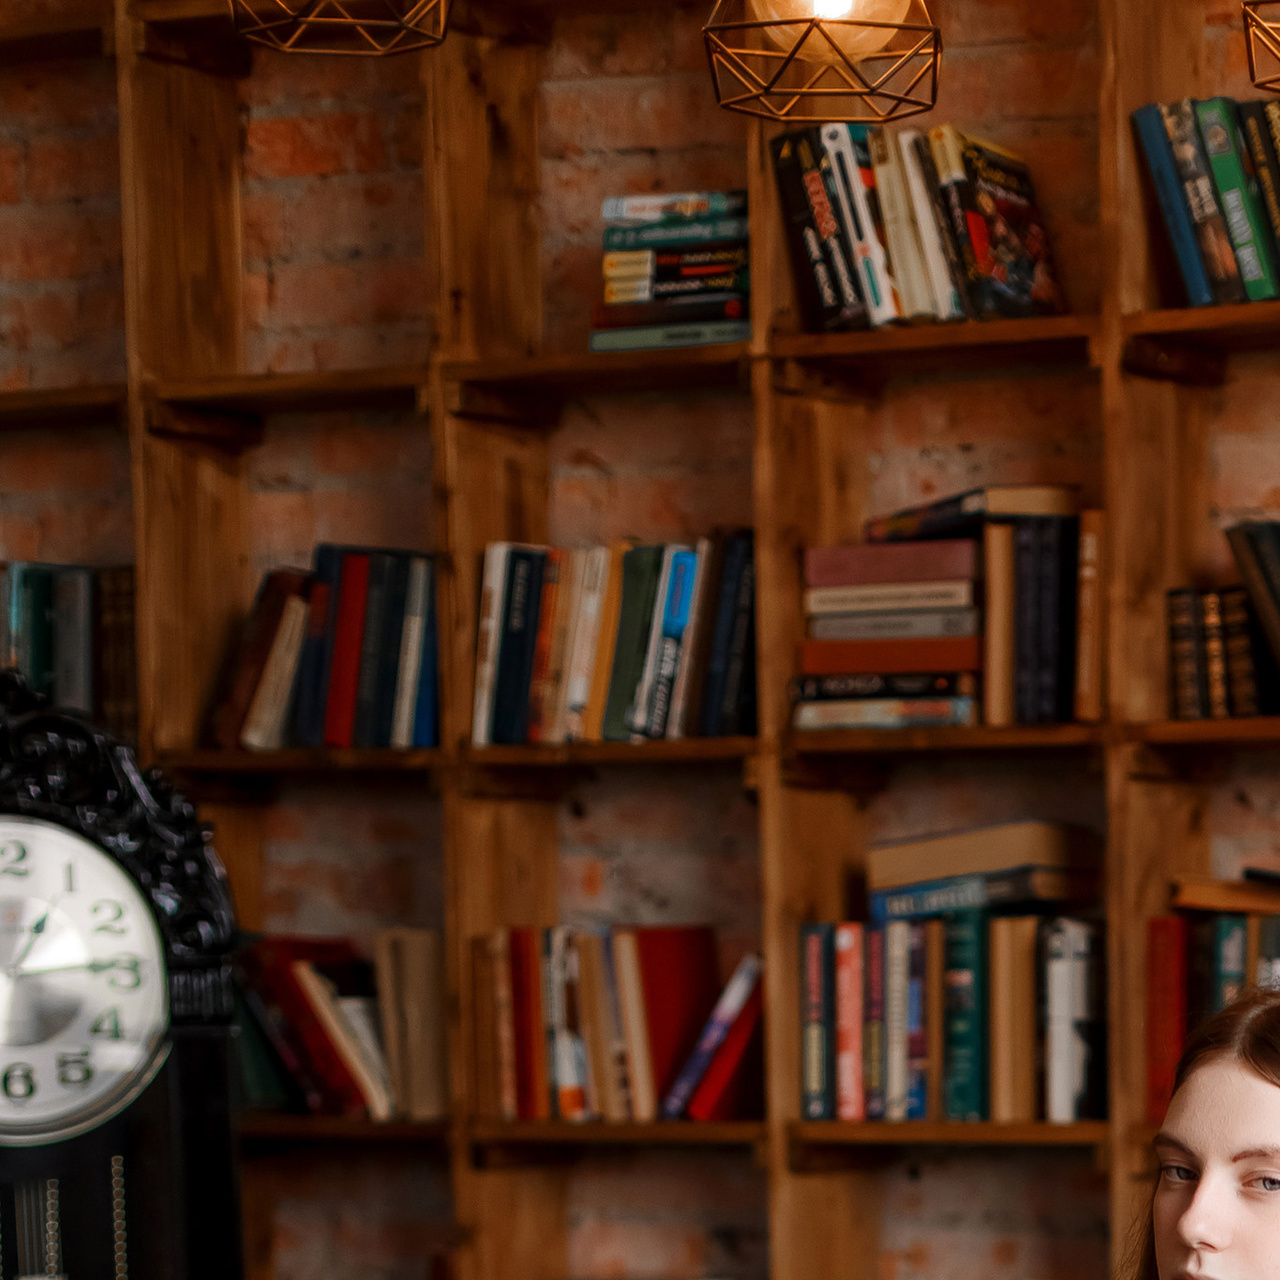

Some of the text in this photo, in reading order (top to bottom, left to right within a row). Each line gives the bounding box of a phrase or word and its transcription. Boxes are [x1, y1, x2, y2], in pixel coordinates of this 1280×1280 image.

[64, 862, 75, 893] 1
[91, 898, 127, 935] 2
[107, 952, 143, 990] 3
[90, 1007, 123, 1040] 4
[2, 1062, 37, 1101] 6
[56, 1046, 94, 1086] 5
